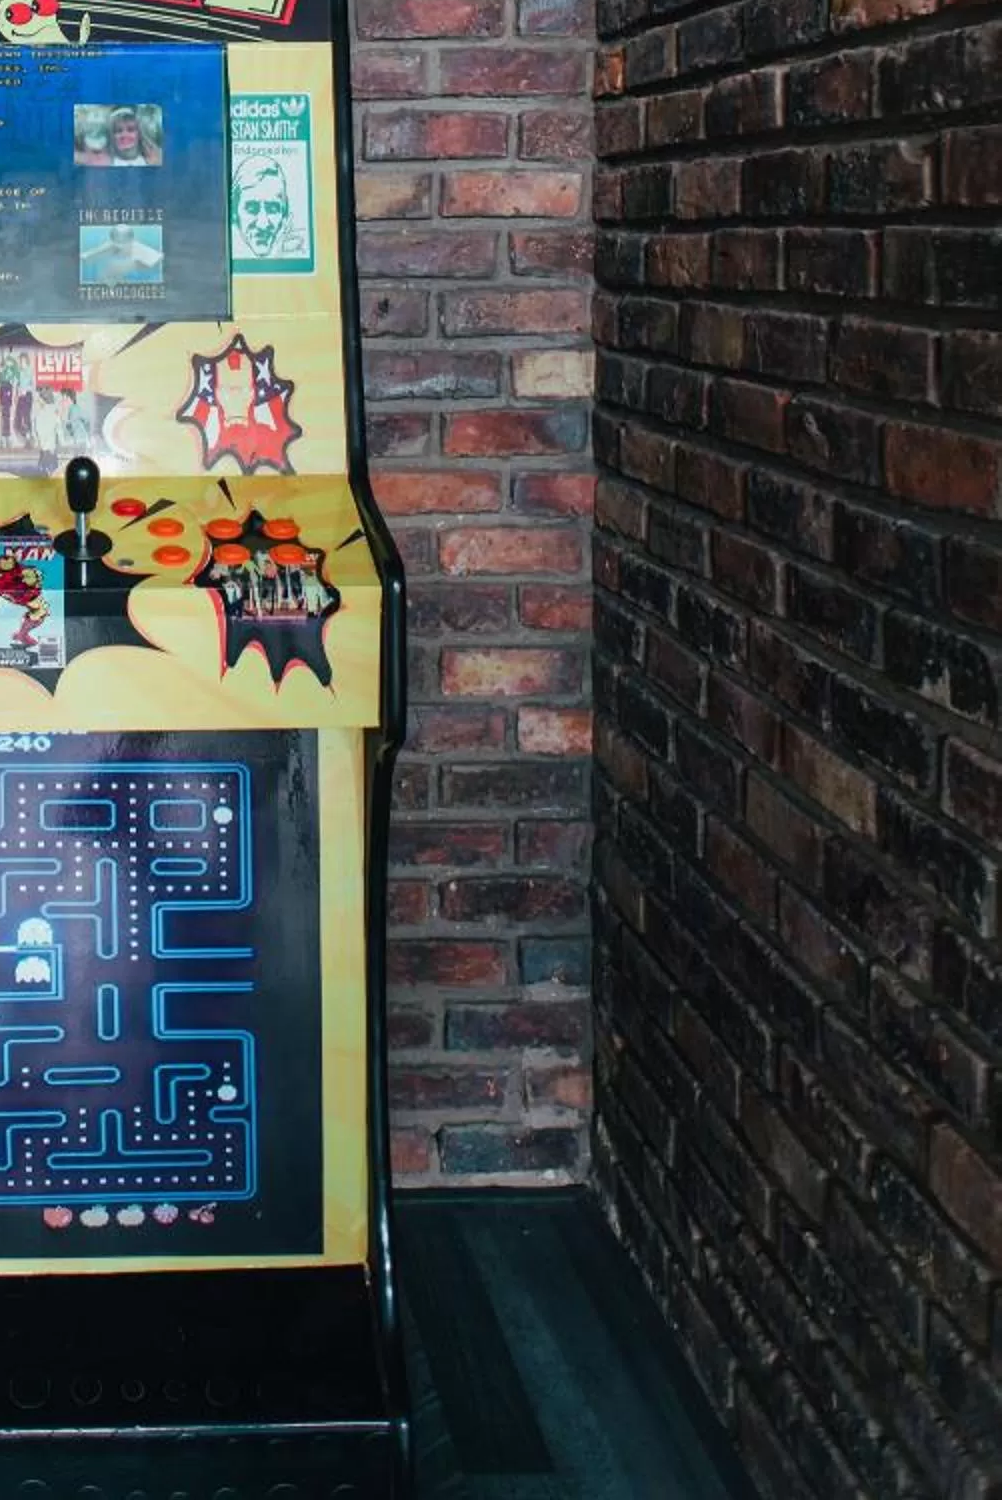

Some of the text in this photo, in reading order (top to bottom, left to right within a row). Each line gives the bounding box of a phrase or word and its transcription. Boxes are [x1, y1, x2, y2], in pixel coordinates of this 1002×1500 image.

[230, 99, 280, 118] didas
[231, 120, 260, 140] STAN
[30, 187, 46, 197] OF
[4, 547, 58, 563] MAN
